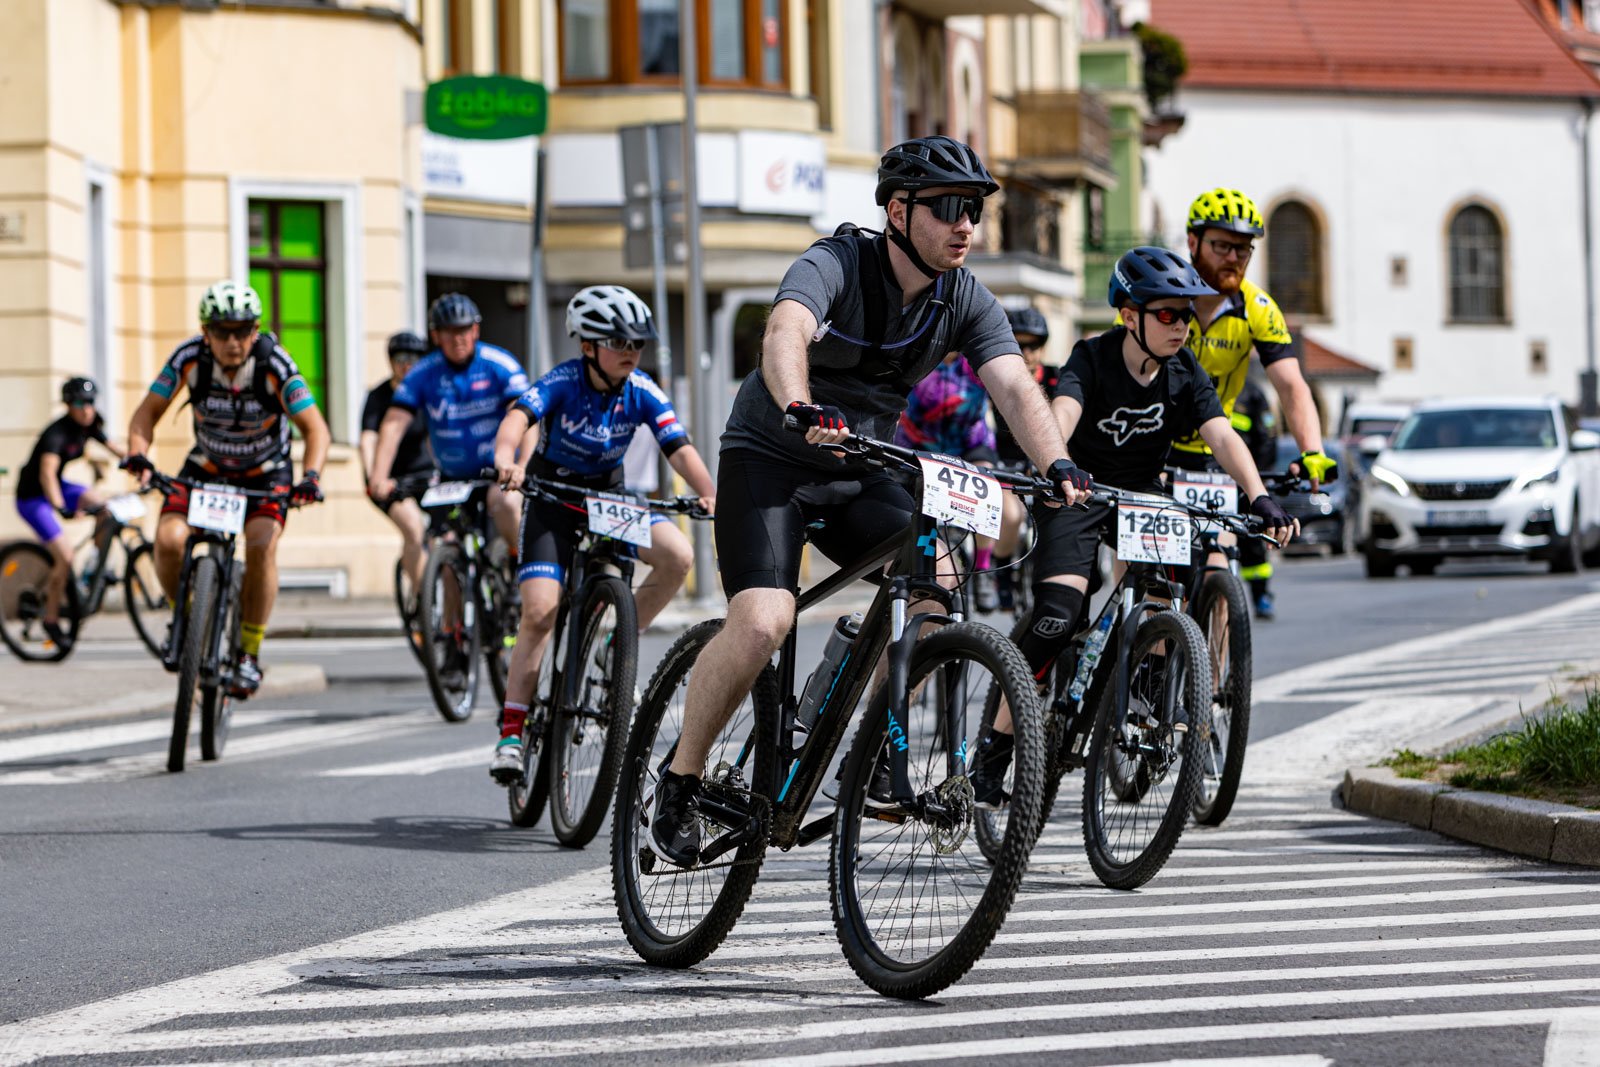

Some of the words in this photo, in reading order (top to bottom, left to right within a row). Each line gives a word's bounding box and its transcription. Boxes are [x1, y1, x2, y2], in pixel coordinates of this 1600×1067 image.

[937, 466, 989, 500] 479
[199, 494, 241, 513] 1229
[1185, 487, 1226, 508] 946
[592, 501, 646, 525] 1467
[1124, 511, 1186, 537] 1286
[834, 806, 845, 919] SCHWALBE
